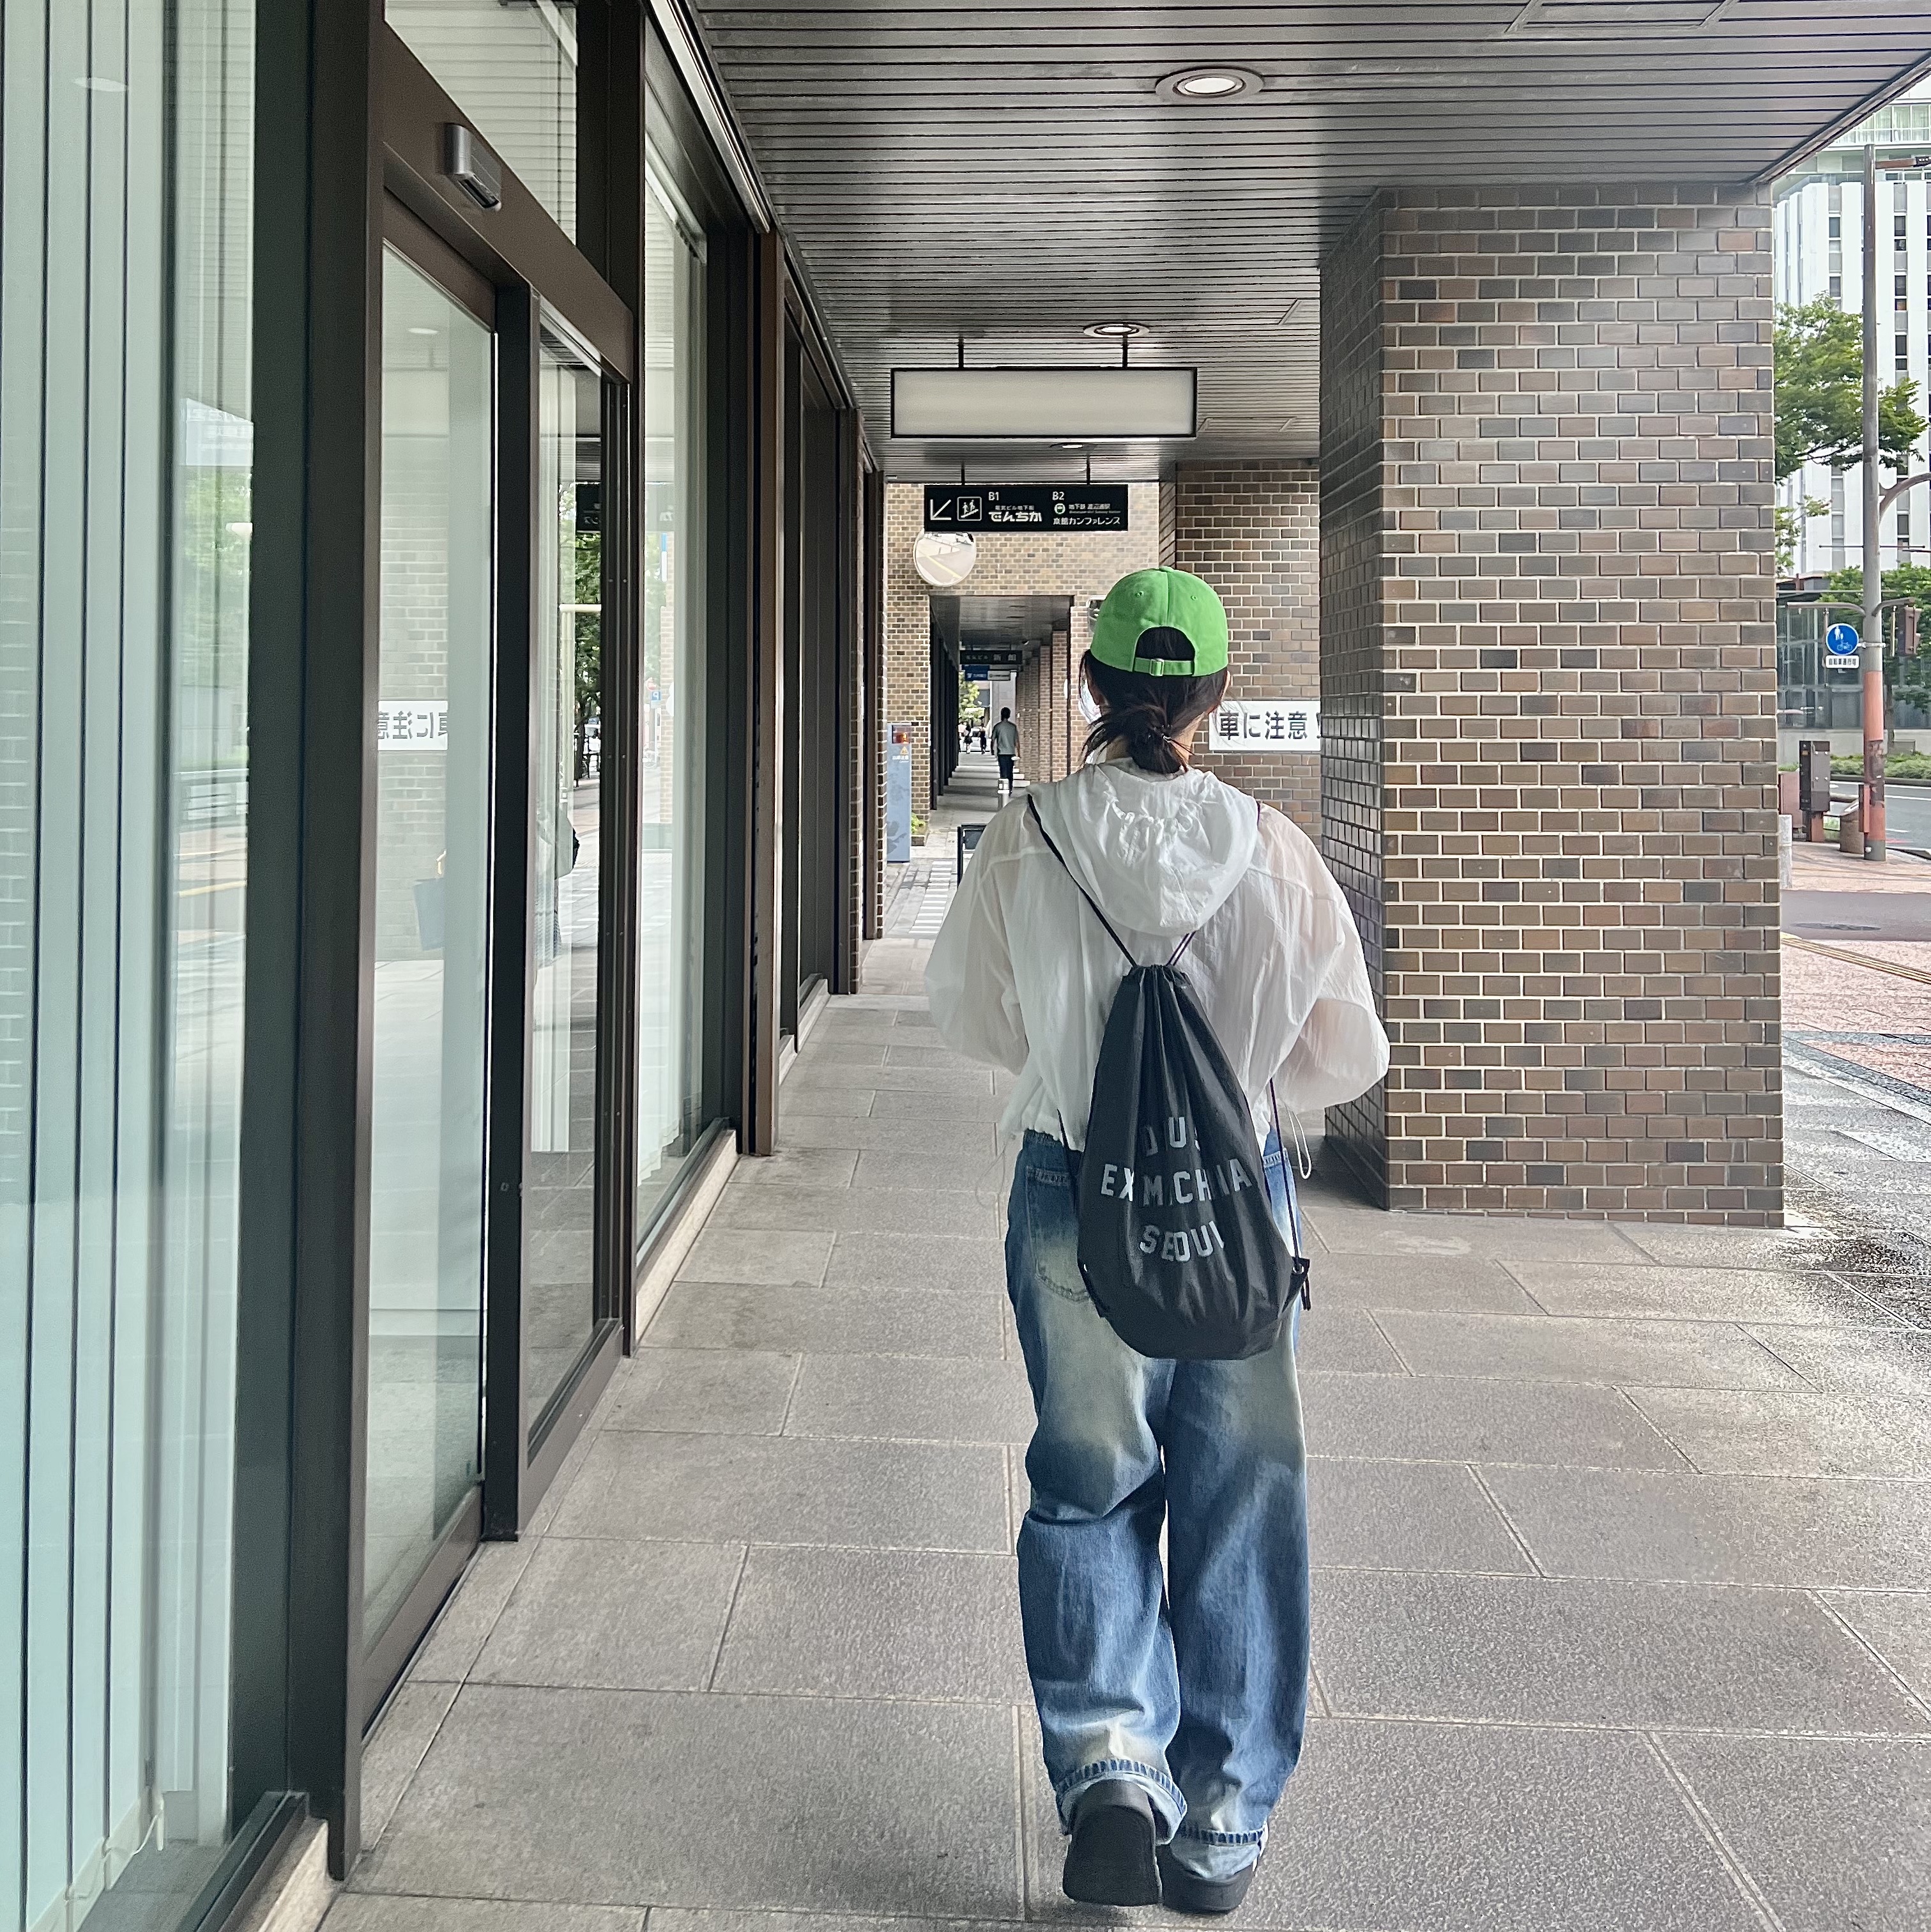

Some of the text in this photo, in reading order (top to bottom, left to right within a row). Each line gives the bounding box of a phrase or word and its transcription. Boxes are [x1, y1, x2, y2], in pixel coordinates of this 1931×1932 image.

[988, 491, 999, 500] B1
[1052, 491, 1065, 500] B2
[988, 511, 1042, 522] でんちか
[1101, 1163, 1134, 1202] EX
